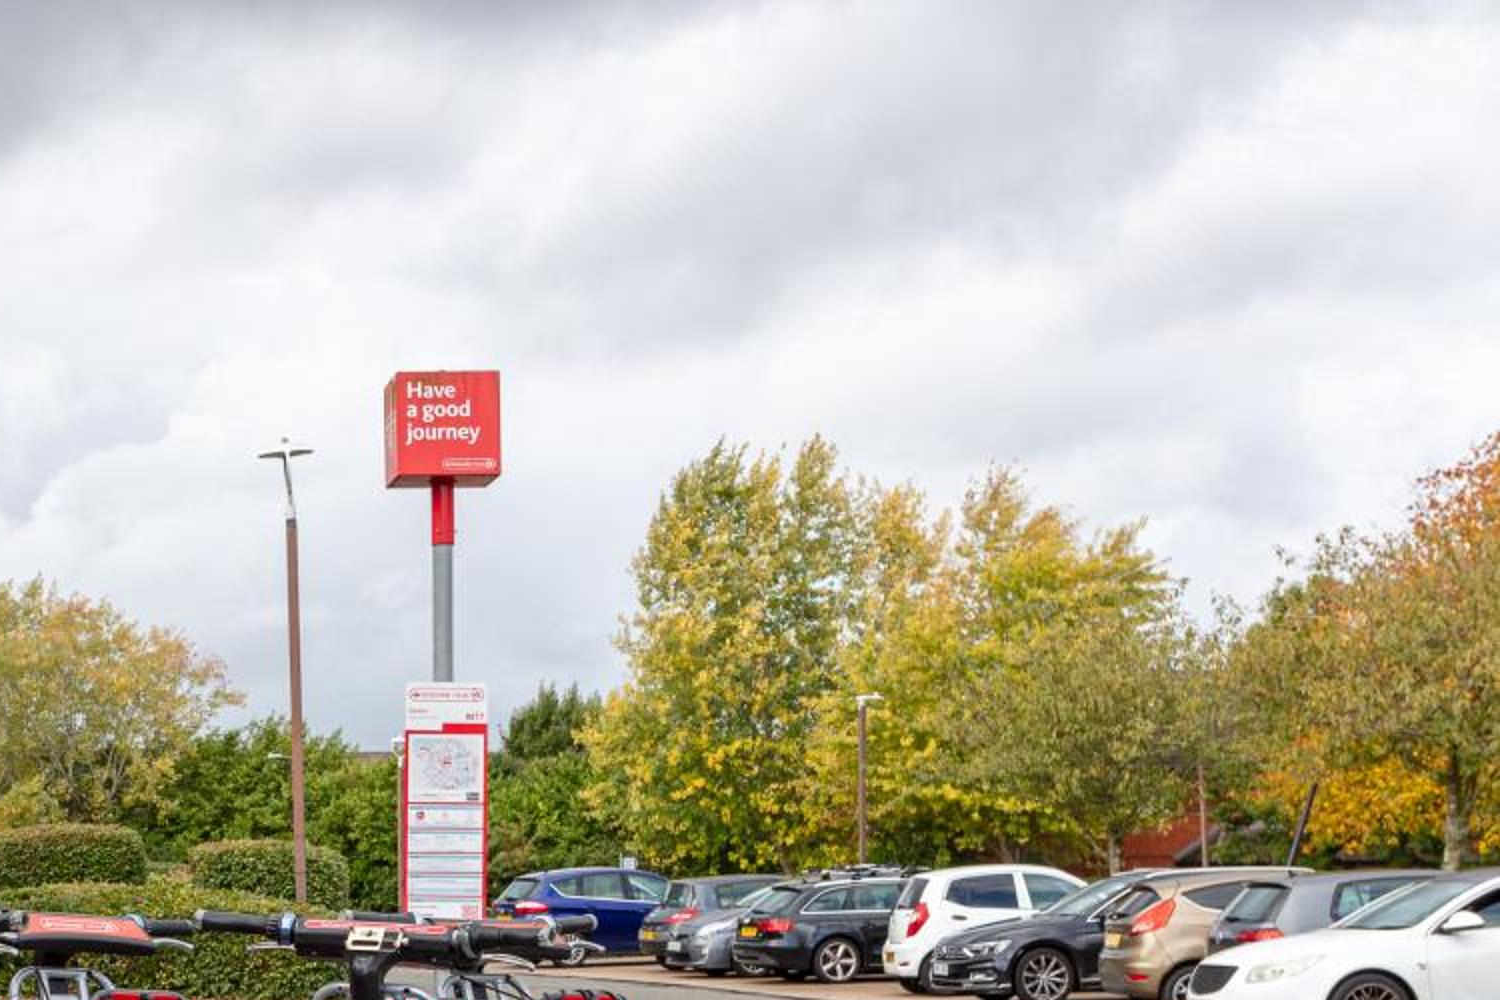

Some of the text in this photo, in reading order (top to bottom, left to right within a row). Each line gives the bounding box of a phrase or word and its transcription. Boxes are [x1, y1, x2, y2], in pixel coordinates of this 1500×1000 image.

[406, 381, 456, 399] Have
[407, 399, 471, 423] a good
[405, 423, 481, 446] journey
